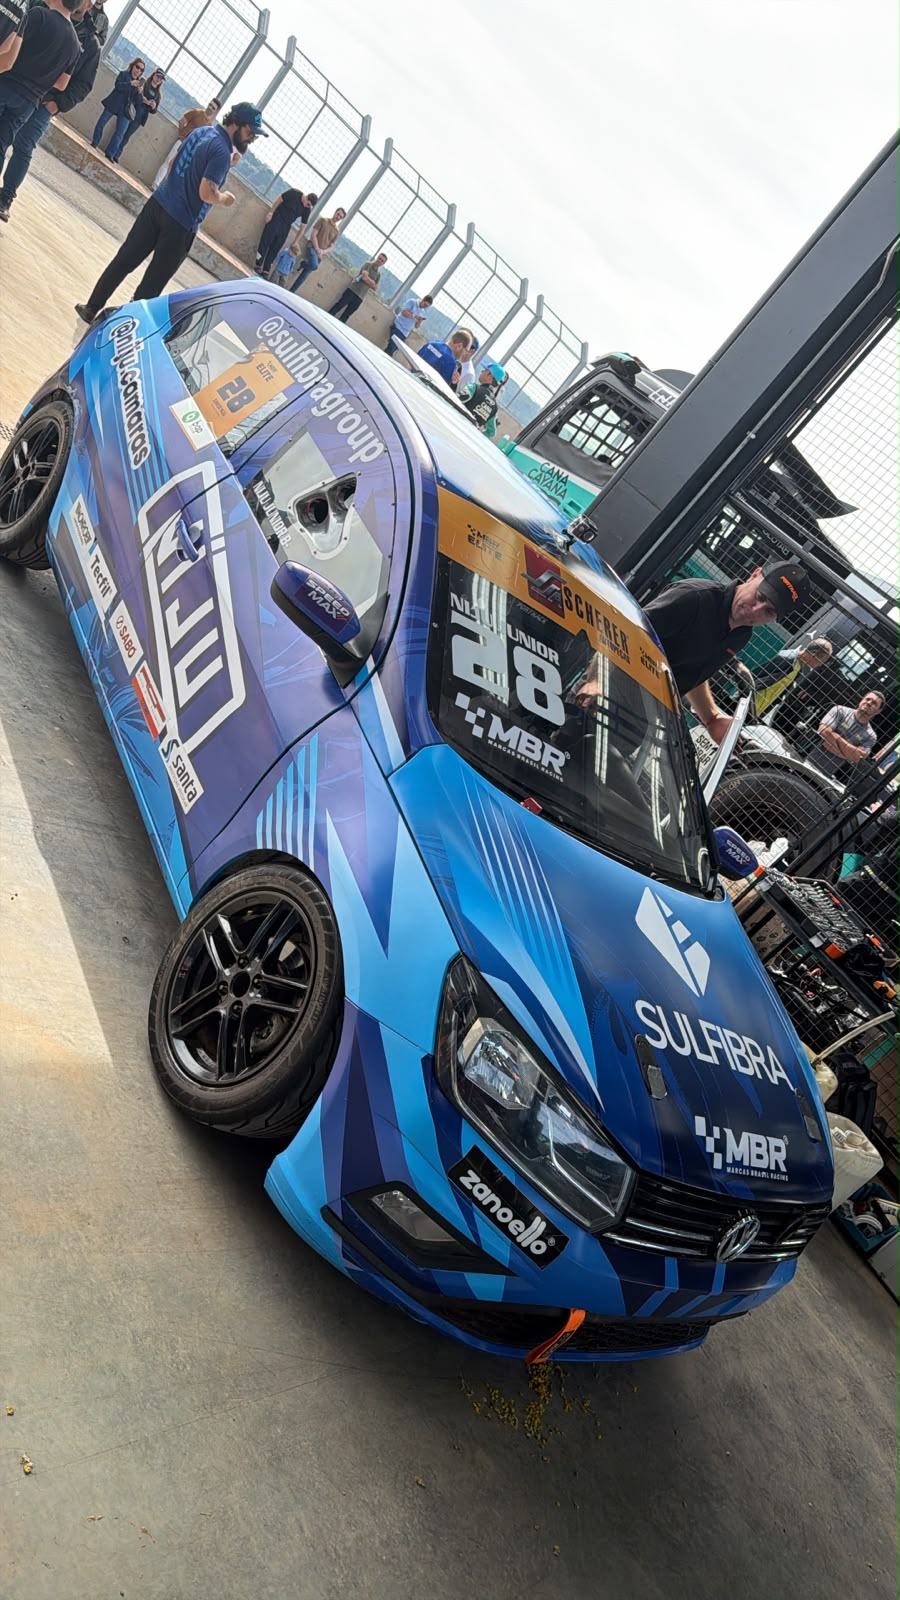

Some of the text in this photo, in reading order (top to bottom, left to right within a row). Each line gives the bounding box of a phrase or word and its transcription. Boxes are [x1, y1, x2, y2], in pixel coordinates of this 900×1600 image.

[216, 376, 256, 415] 28
[255, 363, 275, 384] ELITE
[255, 315, 387, 464] @sulfibragroup
[527, 469, 568, 501] CAYANA
[540, 462, 570, 486] CANA
[90, 553, 111, 599] Tecfil
[304, 579, 350, 617] SPEED
[307, 590, 341, 620] MAX
[563, 587, 629, 655] SCHERER
[500, 618, 561, 667] UNIOR
[450, 610, 566, 726] 28
[486, 712, 566, 777] MBR
[487, 739, 564, 783] MARCAS BRASIL RACING
[696, 734, 713, 752] SEM
[172, 754, 198, 803] santa
[726, 839, 752, 863] SPEED
[727, 847, 750, 868] MAX
[634, 999, 797, 1093] SULFIBRA
[722, 1127, 788, 1173] MBR
[726, 1166, 789, 1182] MARCAS BRASIL RACING
[459, 1169, 548, 1255] zanoello
